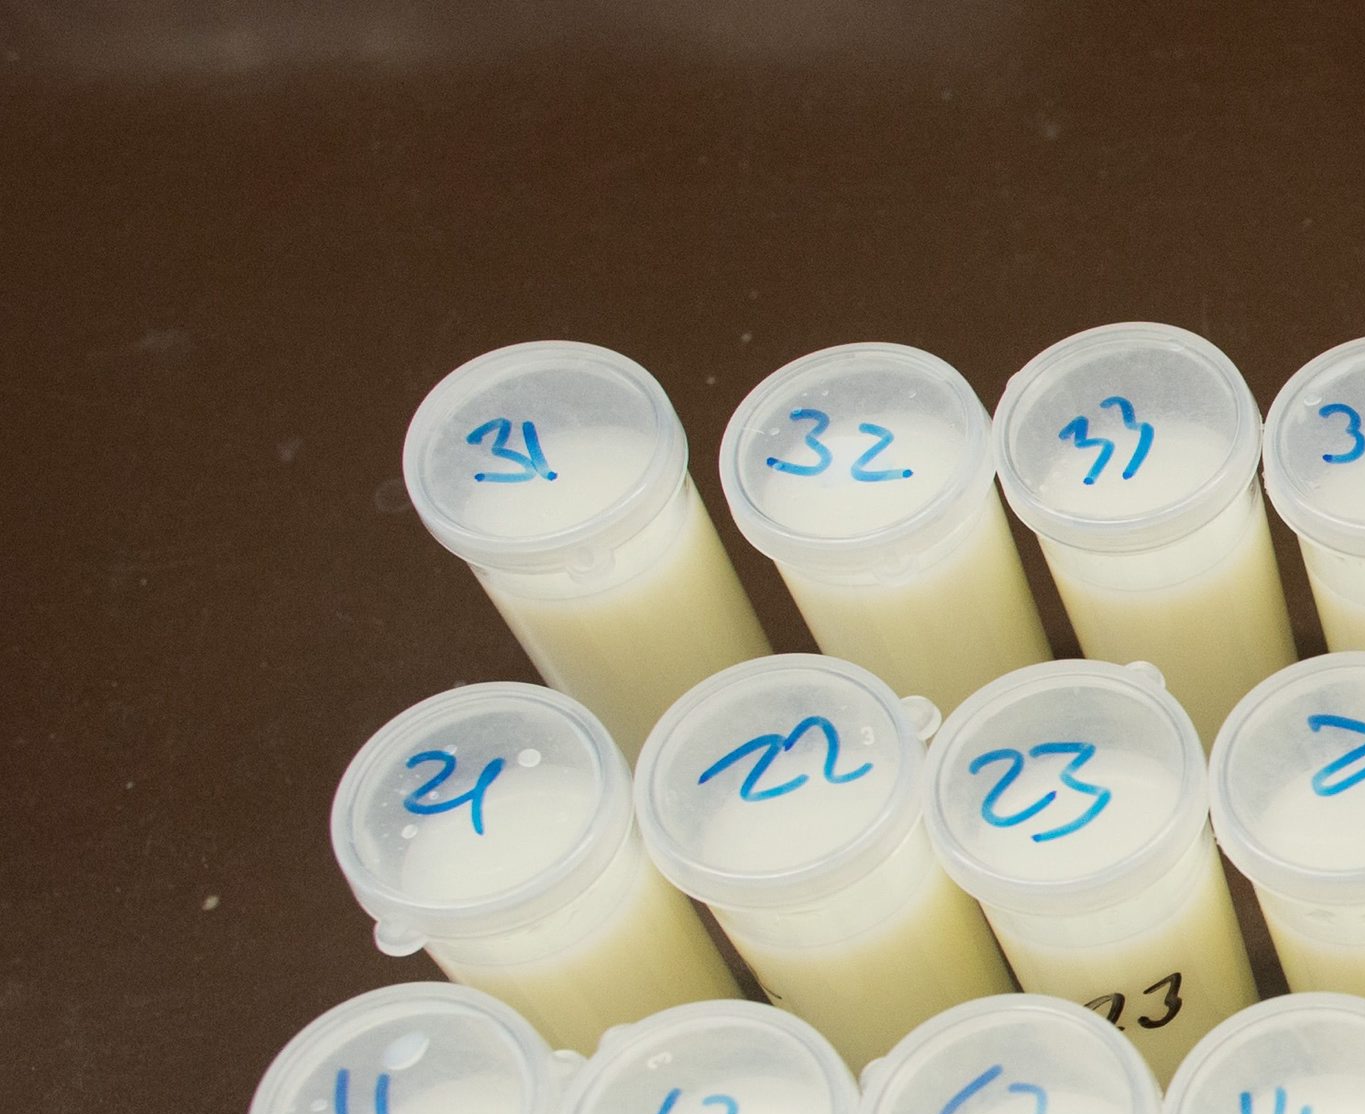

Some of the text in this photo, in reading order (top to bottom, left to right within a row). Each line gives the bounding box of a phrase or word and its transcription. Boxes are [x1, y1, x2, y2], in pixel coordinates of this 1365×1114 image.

[464, 415, 559, 485] 31
[763, 406, 914, 484] 32
[1057, 394, 1156, 487] 33
[401, 747, 507, 837] 21
[696, 714, 875, 803] 22
[967, 740, 1113, 844] 23
